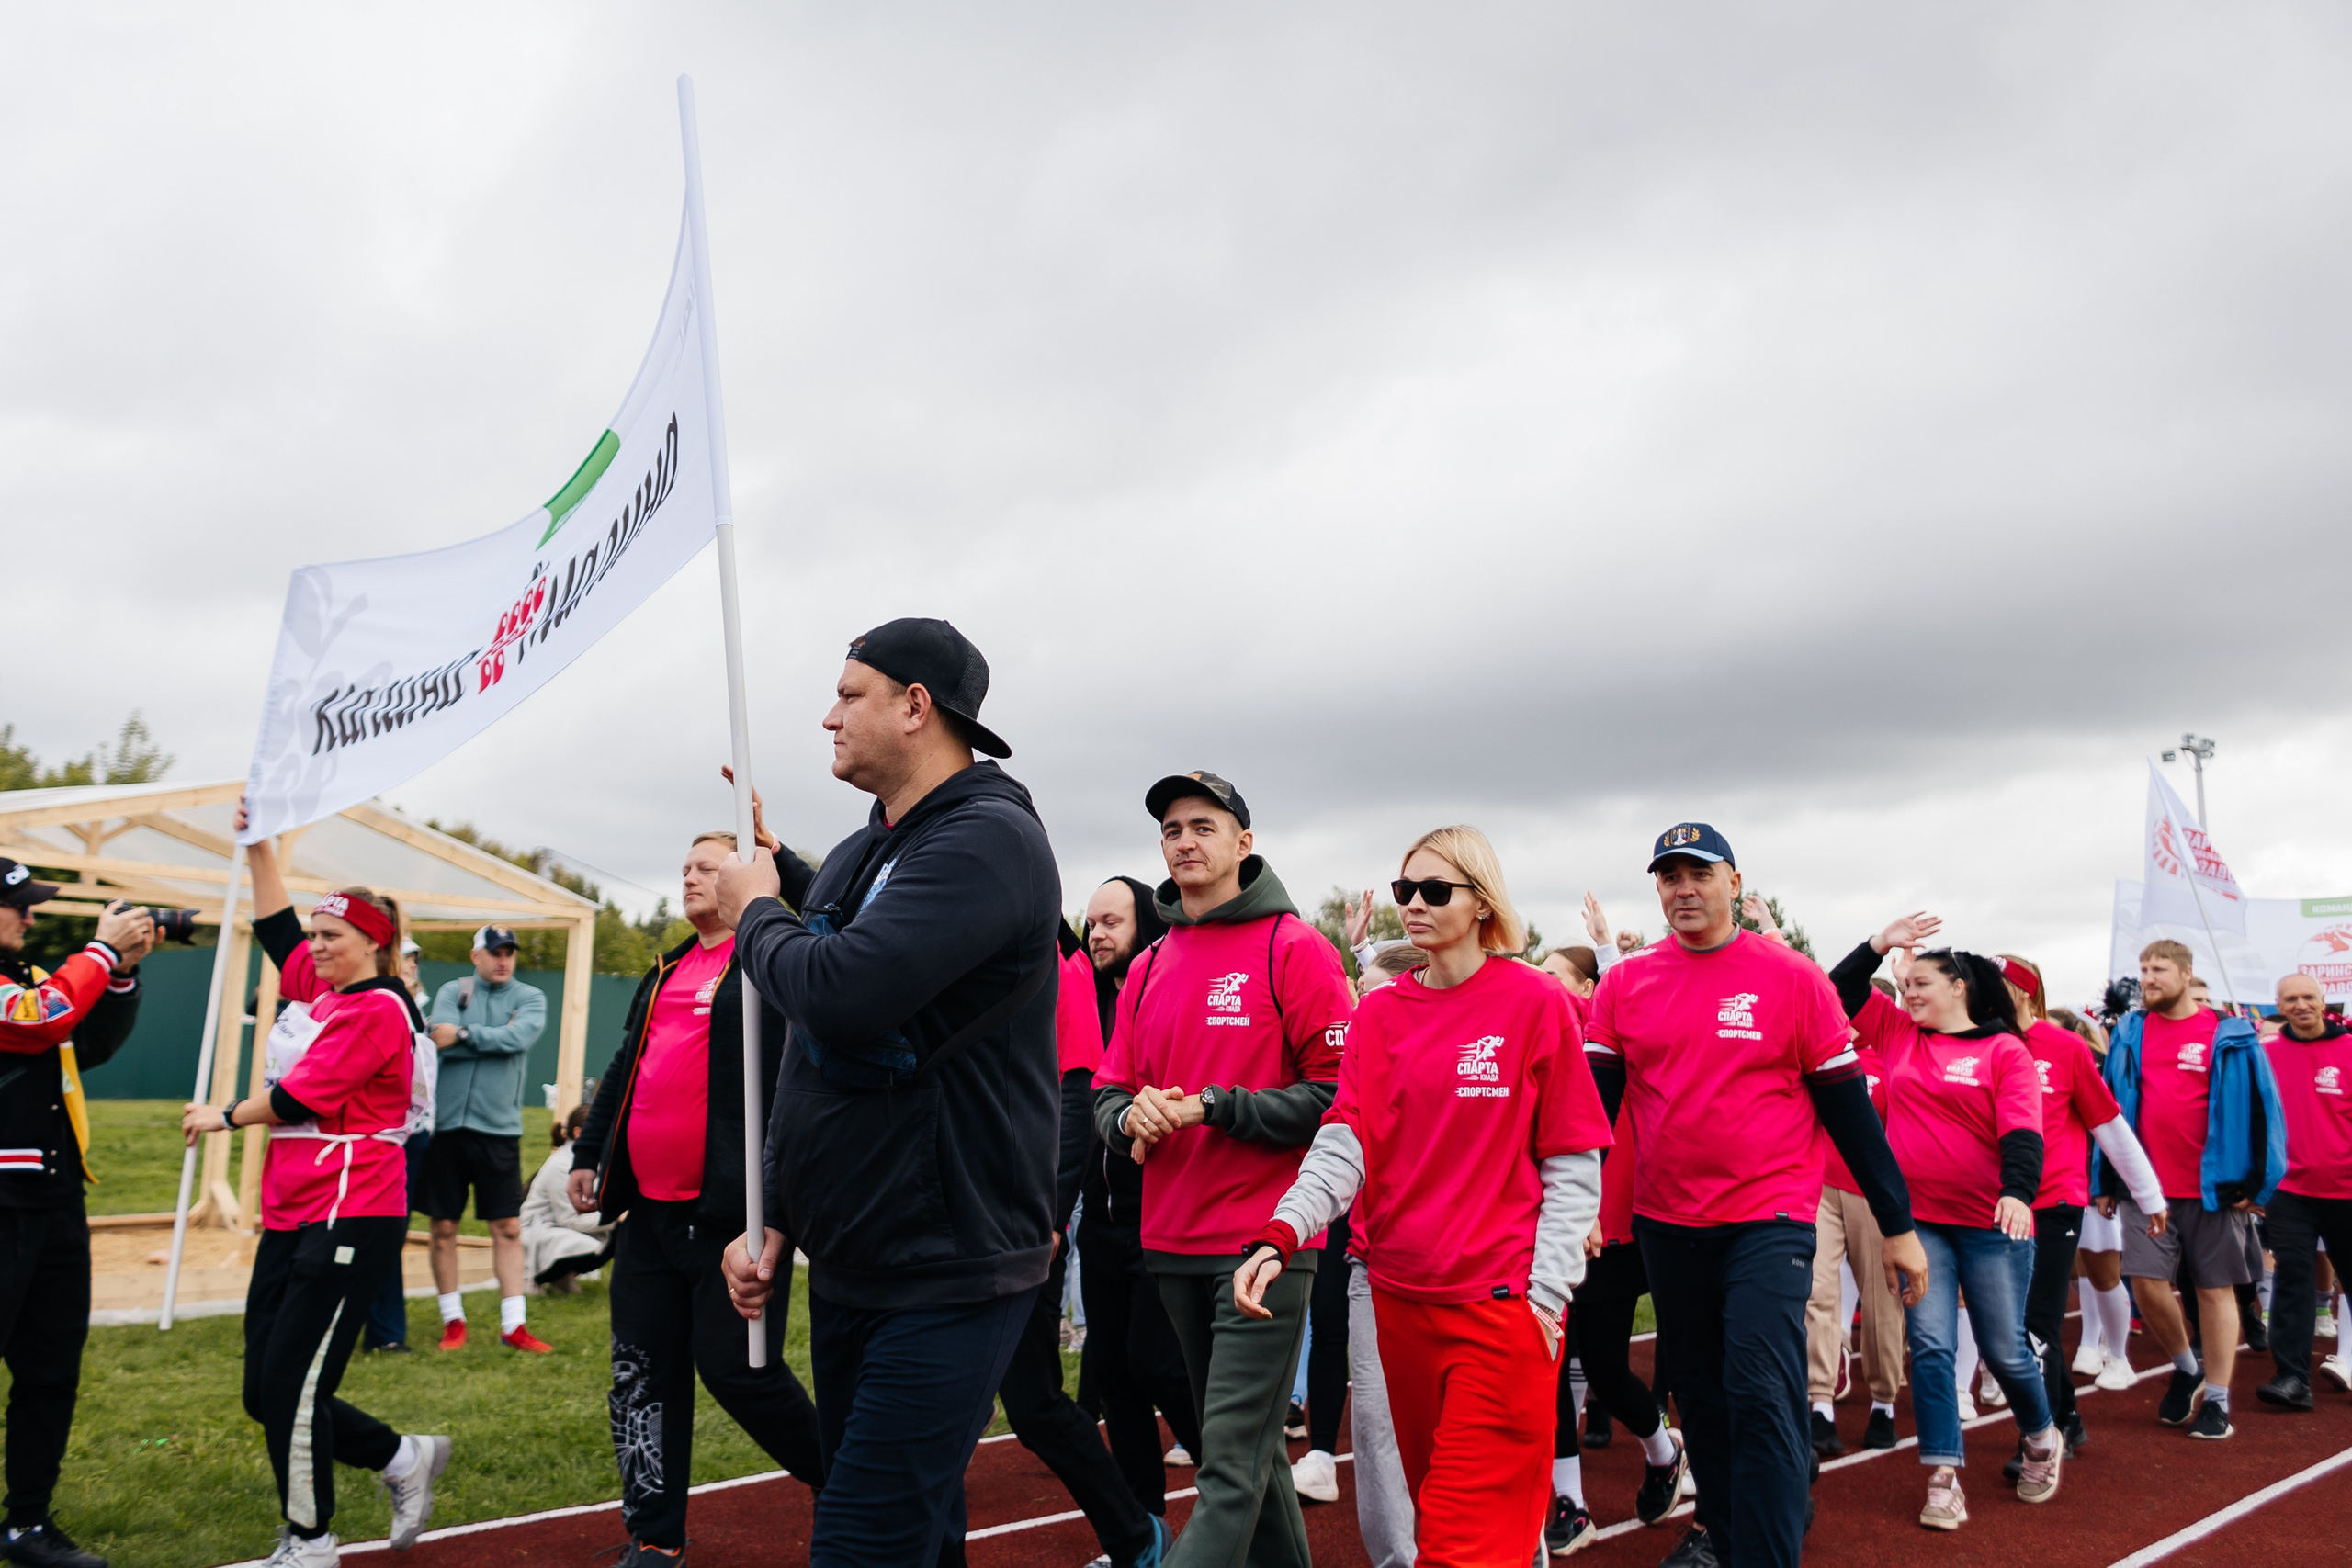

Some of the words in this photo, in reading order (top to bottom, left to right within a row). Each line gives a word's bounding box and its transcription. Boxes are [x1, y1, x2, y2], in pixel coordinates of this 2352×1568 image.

[1207, 995, 1241, 1006] СПАРТА
[1206, 1016, 1250, 1026] СПОРТСМЕН
[1718, 1010, 1753, 1021] СПАРТА
[1717, 1029, 1763, 1041] СПОРТСМЕН
[1457, 1062, 1499, 1075] СПАРТА
[1480, 1074, 1499, 1082] КИАДА
[1456, 1087, 1510, 1097] СПОРТСМЕН
